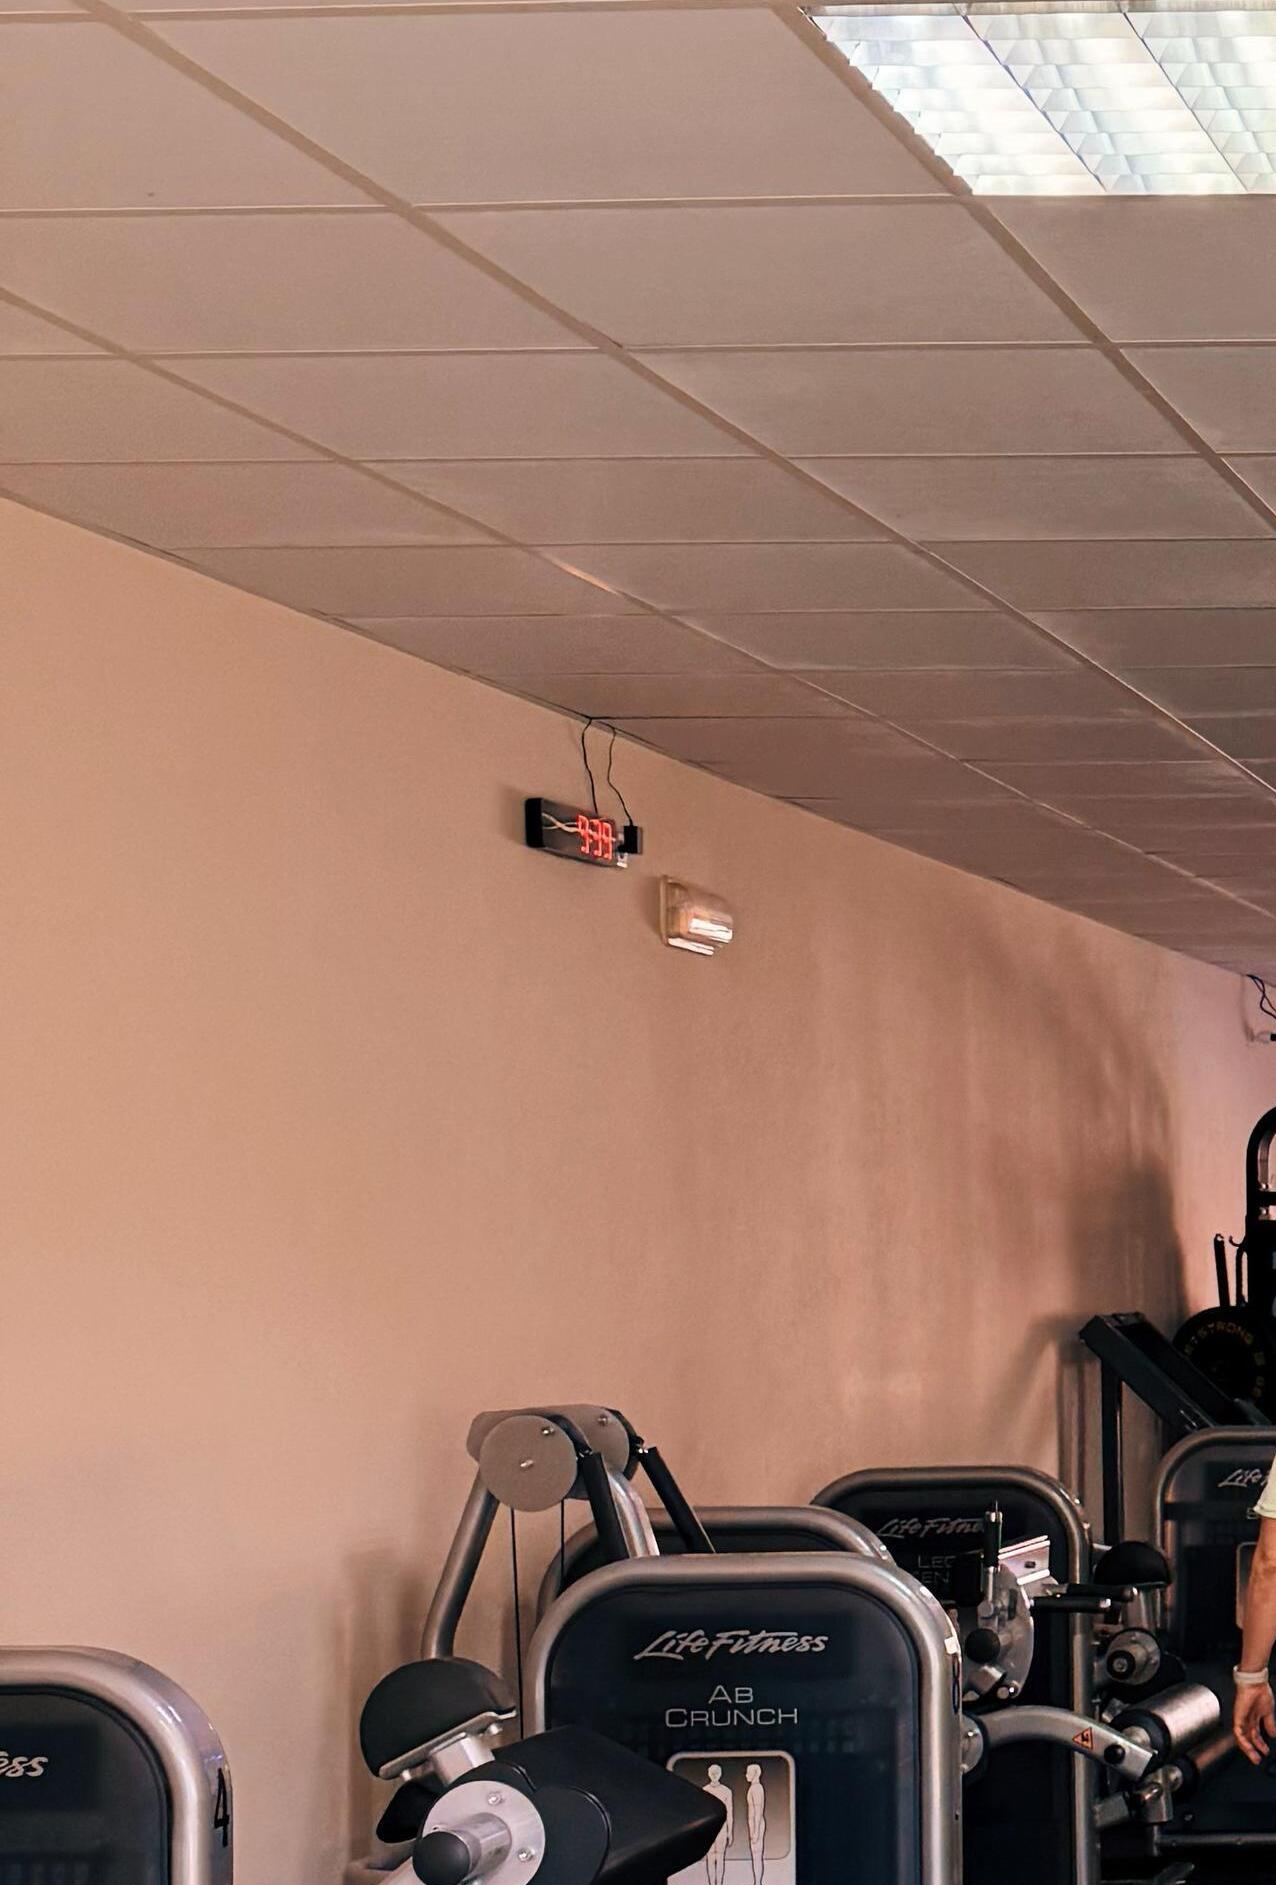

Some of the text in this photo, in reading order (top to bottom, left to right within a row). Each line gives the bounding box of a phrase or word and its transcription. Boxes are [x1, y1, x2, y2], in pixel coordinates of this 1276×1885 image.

[633, 1629, 829, 1660] Life Fitness
[708, 1685, 754, 1704] AB
[665, 1708, 799, 1728] CRUNCH
[213, 1767, 230, 1848] 4
